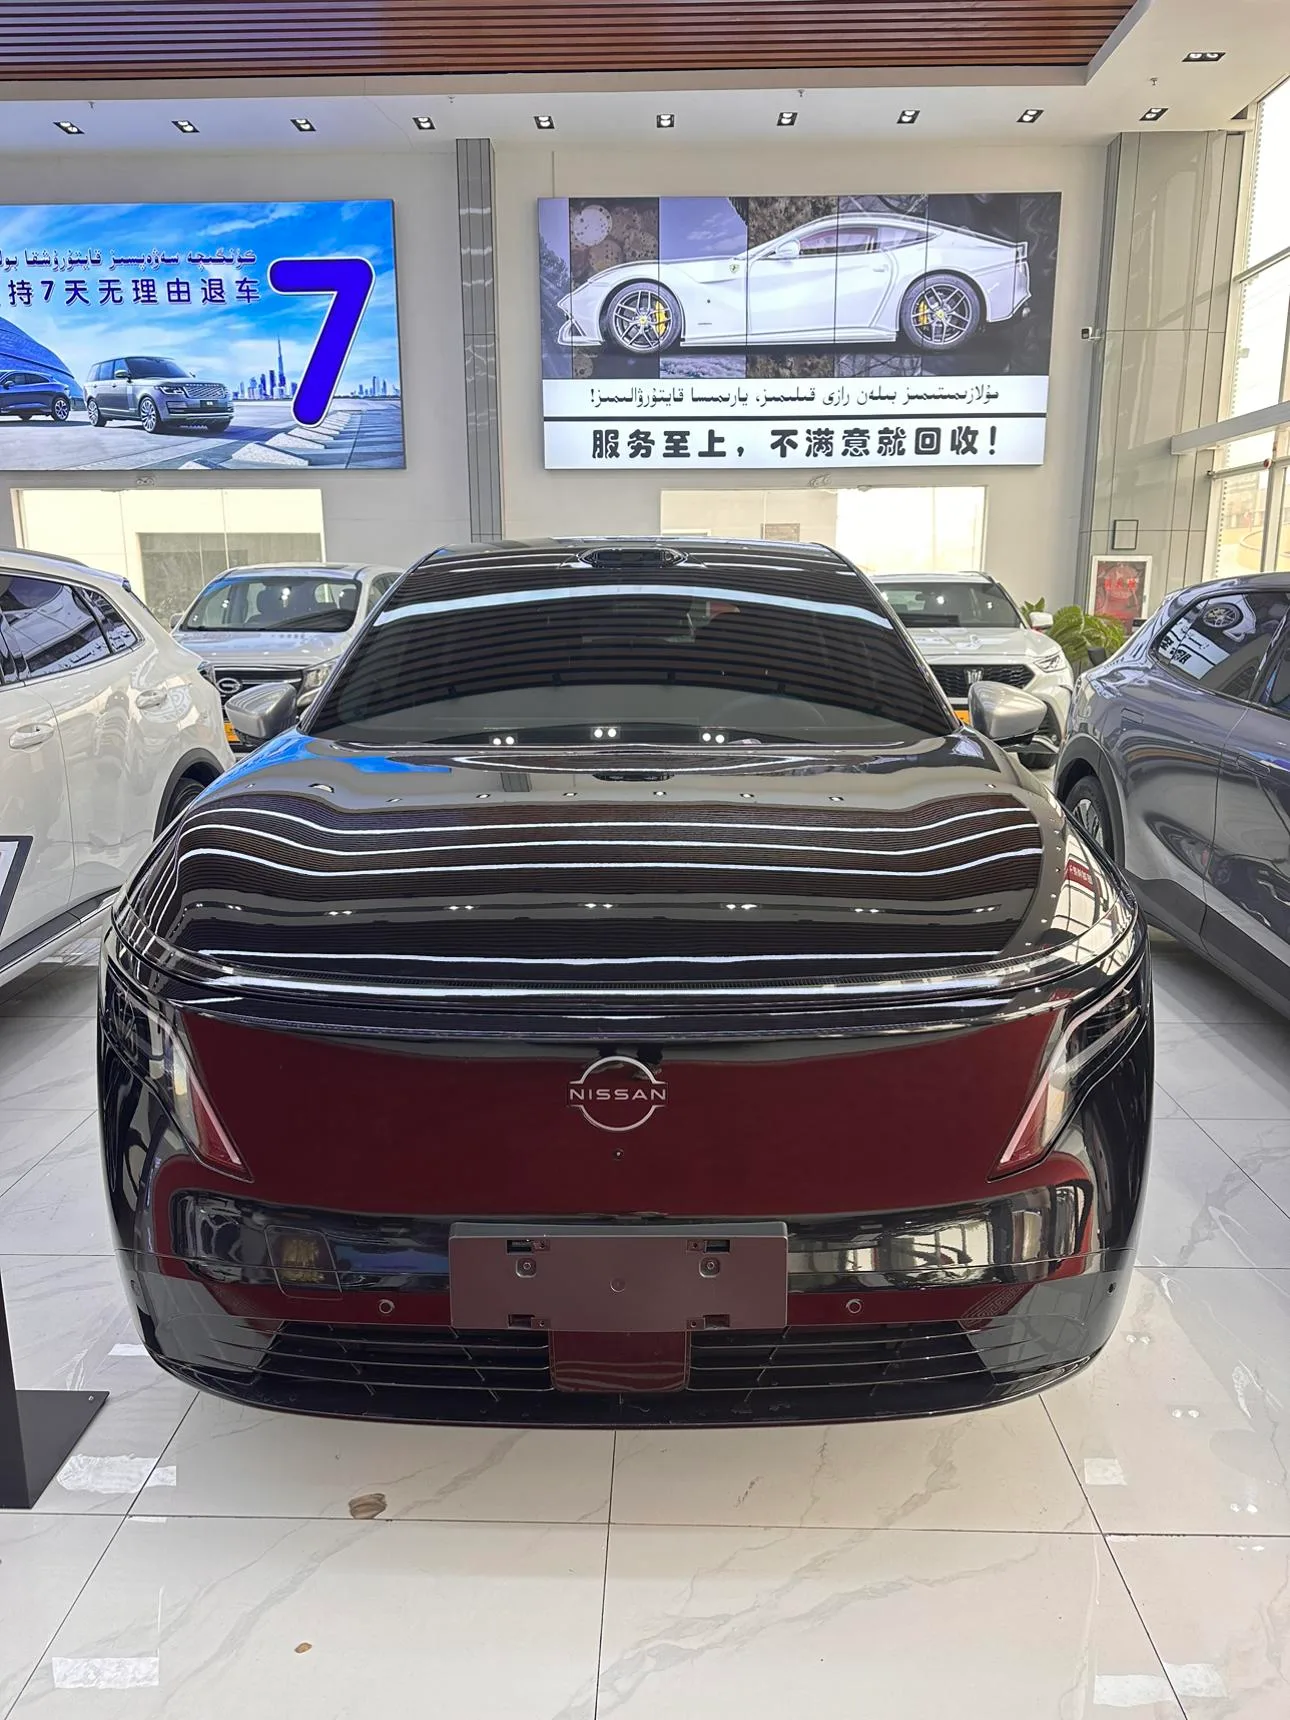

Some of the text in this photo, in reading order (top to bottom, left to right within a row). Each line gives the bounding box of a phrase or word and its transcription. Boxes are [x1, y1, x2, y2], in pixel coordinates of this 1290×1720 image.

[0, 277, 260, 306] 持7天无理由退车
[269, 257, 375, 428] 7
[569, 1088, 666, 1100] NISSAN
